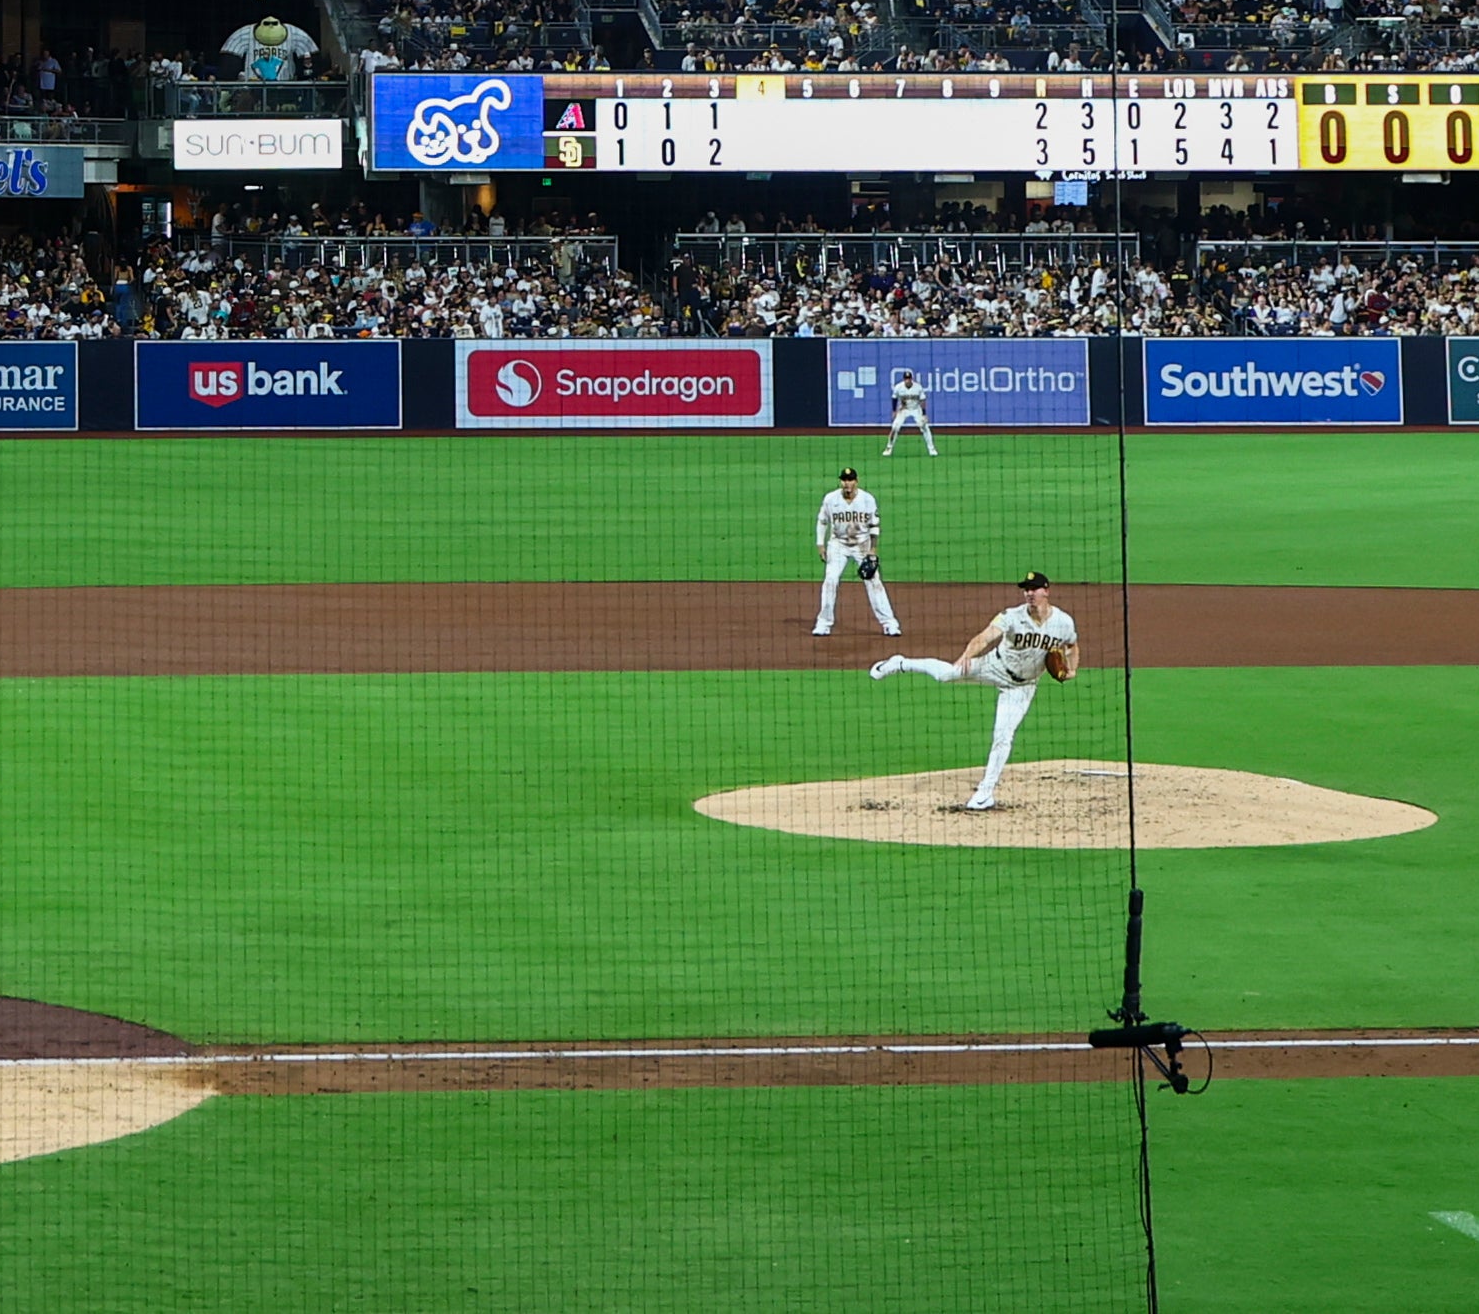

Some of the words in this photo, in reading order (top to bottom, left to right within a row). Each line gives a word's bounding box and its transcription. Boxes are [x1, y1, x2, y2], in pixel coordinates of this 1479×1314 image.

[193, 369, 239, 396] us
[247, 361, 343, 396] bank
[555, 369, 735, 402] Snapdragon
[1160, 362, 1358, 398] Southwest
[831, 512, 870, 524] PADRES
